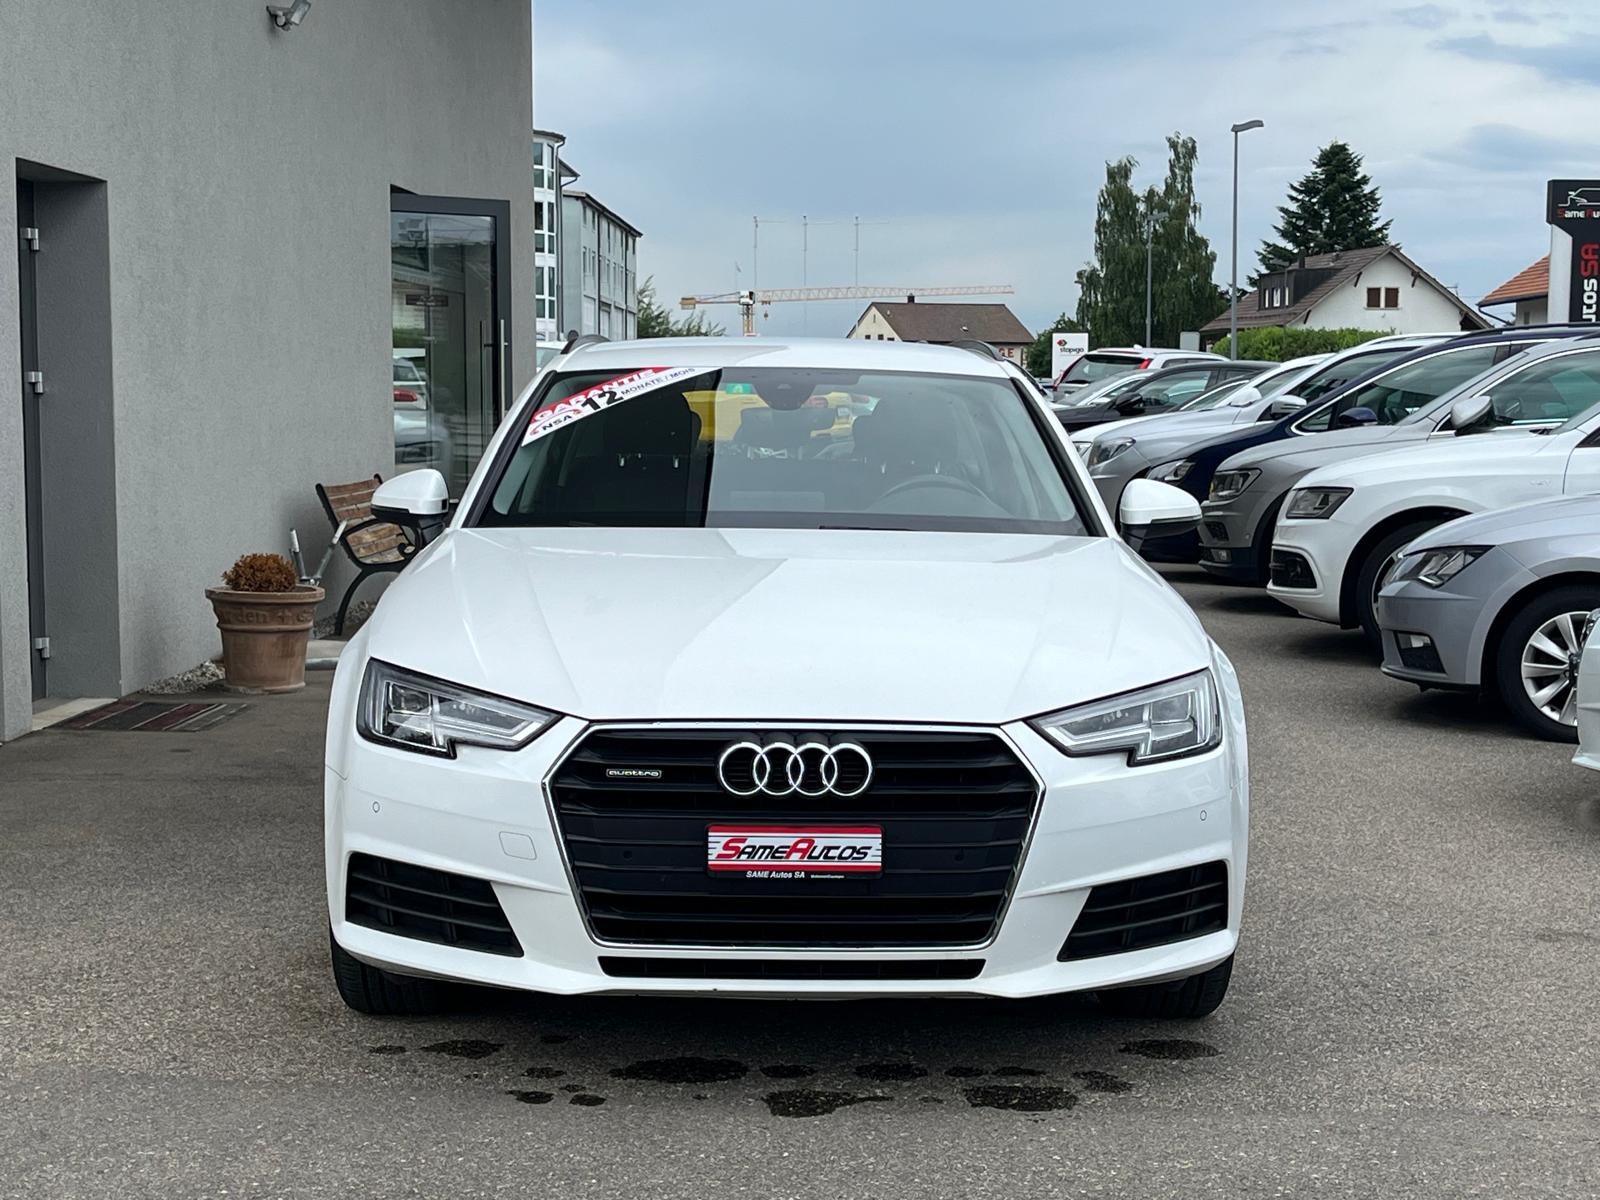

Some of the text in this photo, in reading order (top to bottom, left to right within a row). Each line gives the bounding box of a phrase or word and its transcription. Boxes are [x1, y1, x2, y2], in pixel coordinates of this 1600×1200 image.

[581, 390, 624, 411] 12
[542, 414, 572, 431] NSA
[746, 870, 769, 878] SAME
[770, 871, 793, 879] Autos
[794, 871, 805, 879] SA
